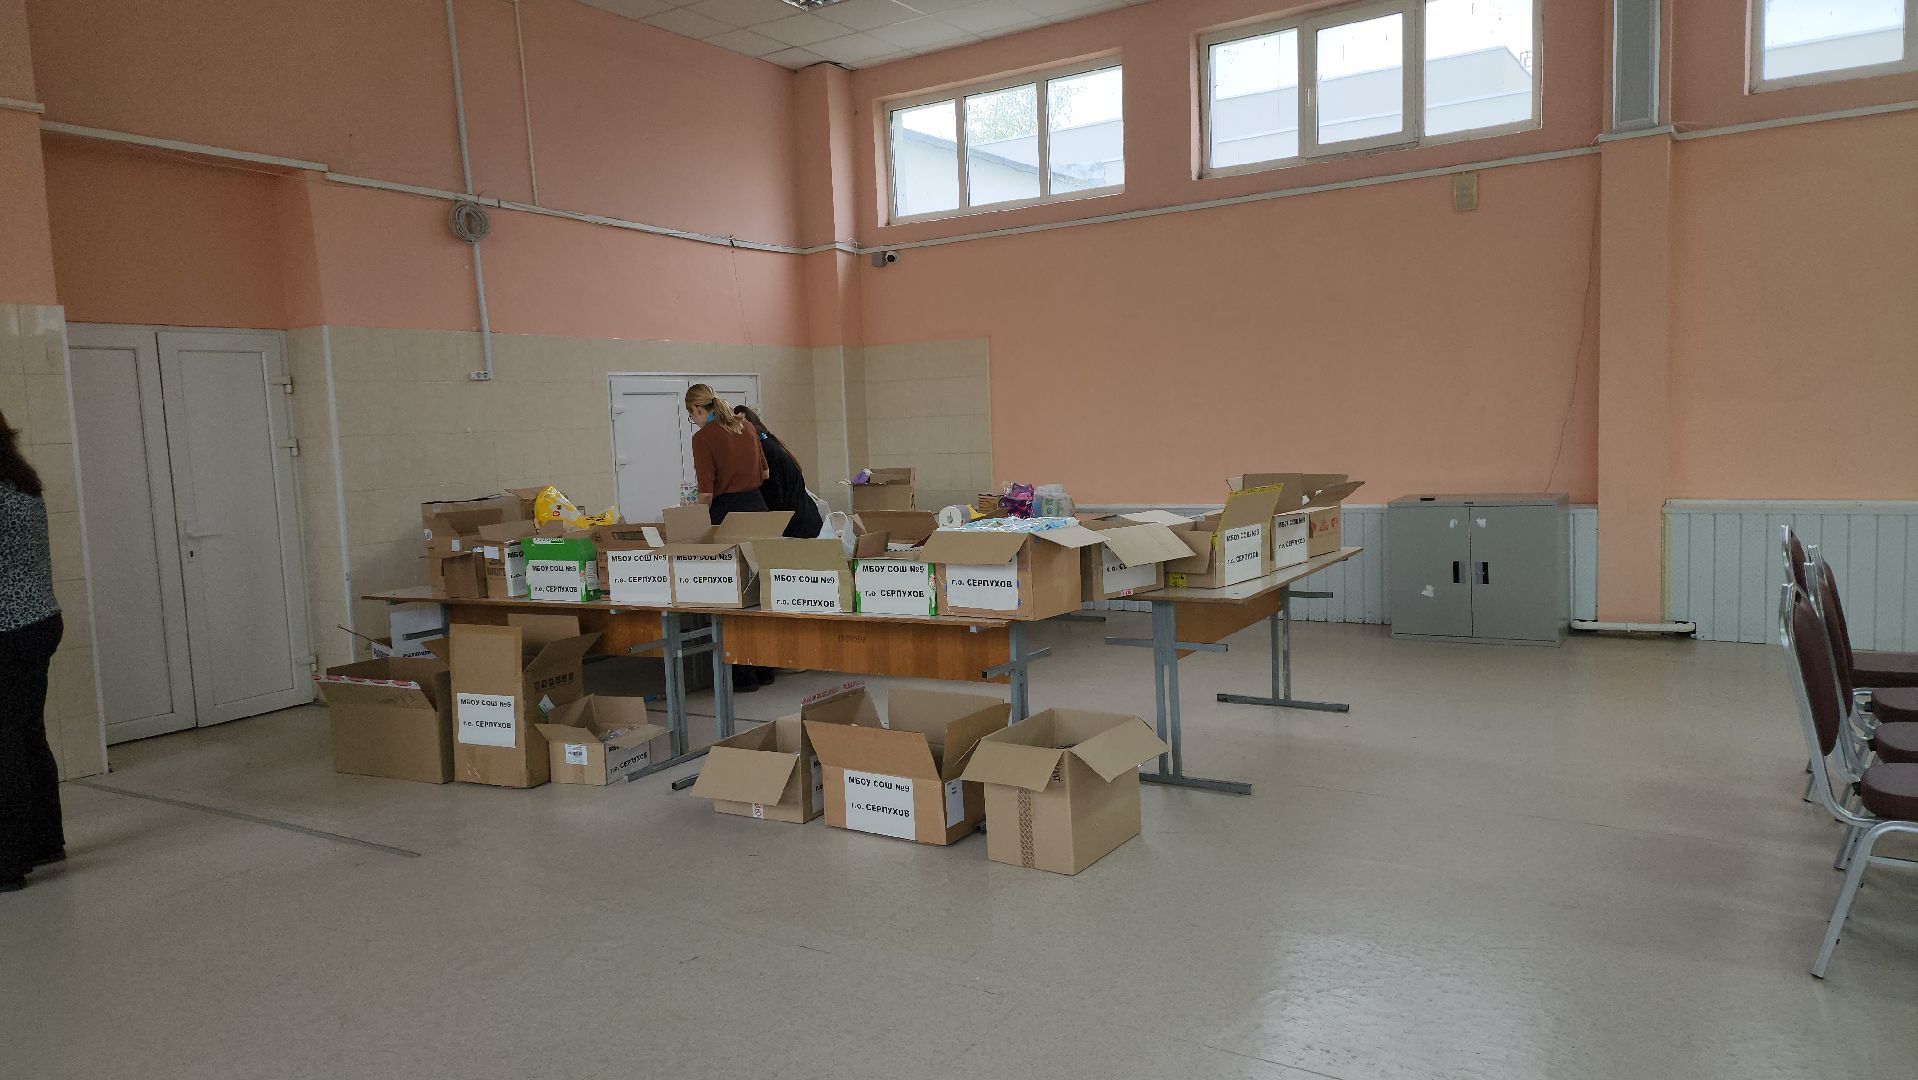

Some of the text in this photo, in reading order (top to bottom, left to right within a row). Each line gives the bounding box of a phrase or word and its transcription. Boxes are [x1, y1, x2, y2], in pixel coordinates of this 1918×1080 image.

[507, 551, 525, 559] МБО
[633, 554, 652, 562] СОШ
[862, 565, 925, 573] МБОУ СОШ №9
[628, 575, 668, 583] СЕРПУХОВ
[692, 576, 734, 584] СЕРПУХОВ
[774, 574, 835, 584] МБОУ СОШ №9
[966, 578, 1013, 588] СЕРПУХОВ
[545, 585, 578, 593] СЕРПУХОВ
[880, 589, 925, 598] СЕРПУХОВ
[791, 598, 835, 608] СЕРПУХОВ
[460, 698, 480, 706] МБОУ
[475, 720, 512, 729] СЕРПУХОВ
[619, 751, 648, 769] СЕРПУХОВ
[848, 776, 910, 793] МБОУ СОШ №9
[865, 803, 910, 818] СЕРПУХОВ
